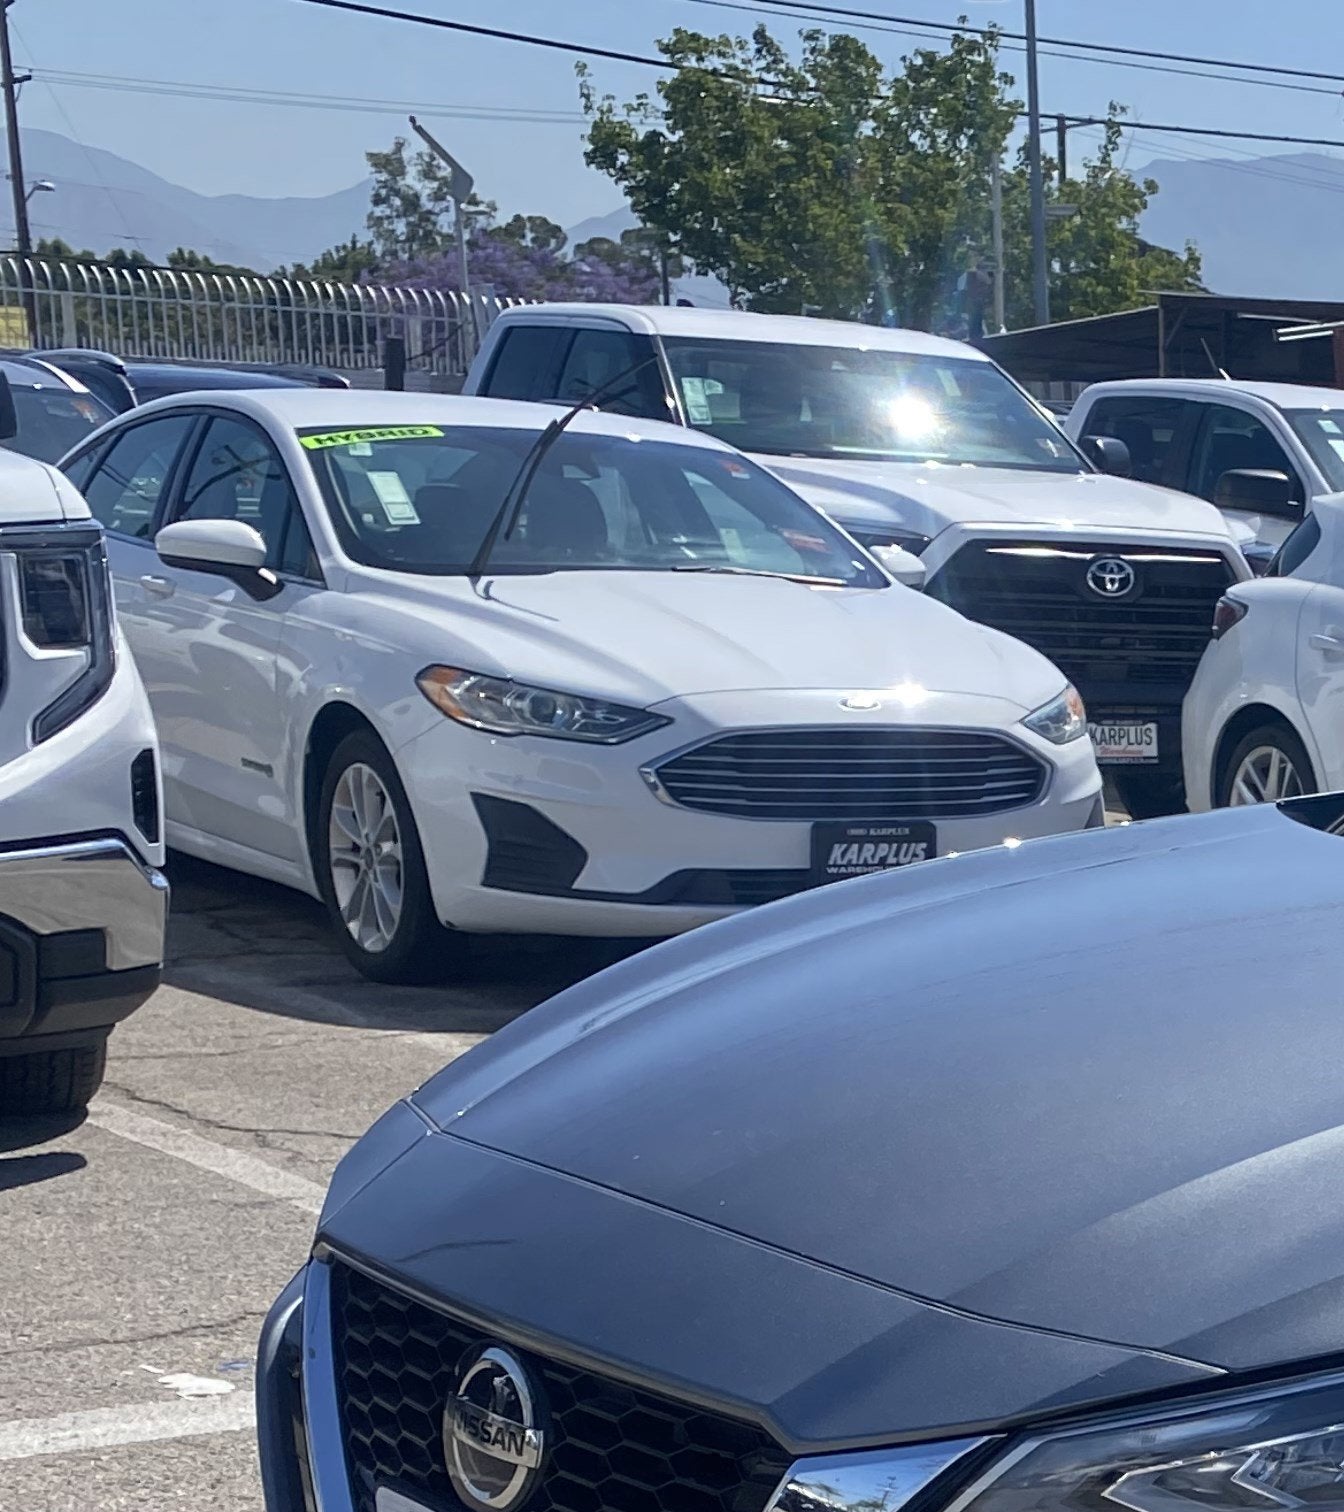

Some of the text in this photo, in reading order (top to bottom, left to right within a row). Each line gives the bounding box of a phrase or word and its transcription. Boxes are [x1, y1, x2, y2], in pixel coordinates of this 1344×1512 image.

[1089, 727, 1153, 746] KARPLUS
[828, 842, 928, 865] KARPLUS
[453, 1403, 526, 1457] NISSAN
